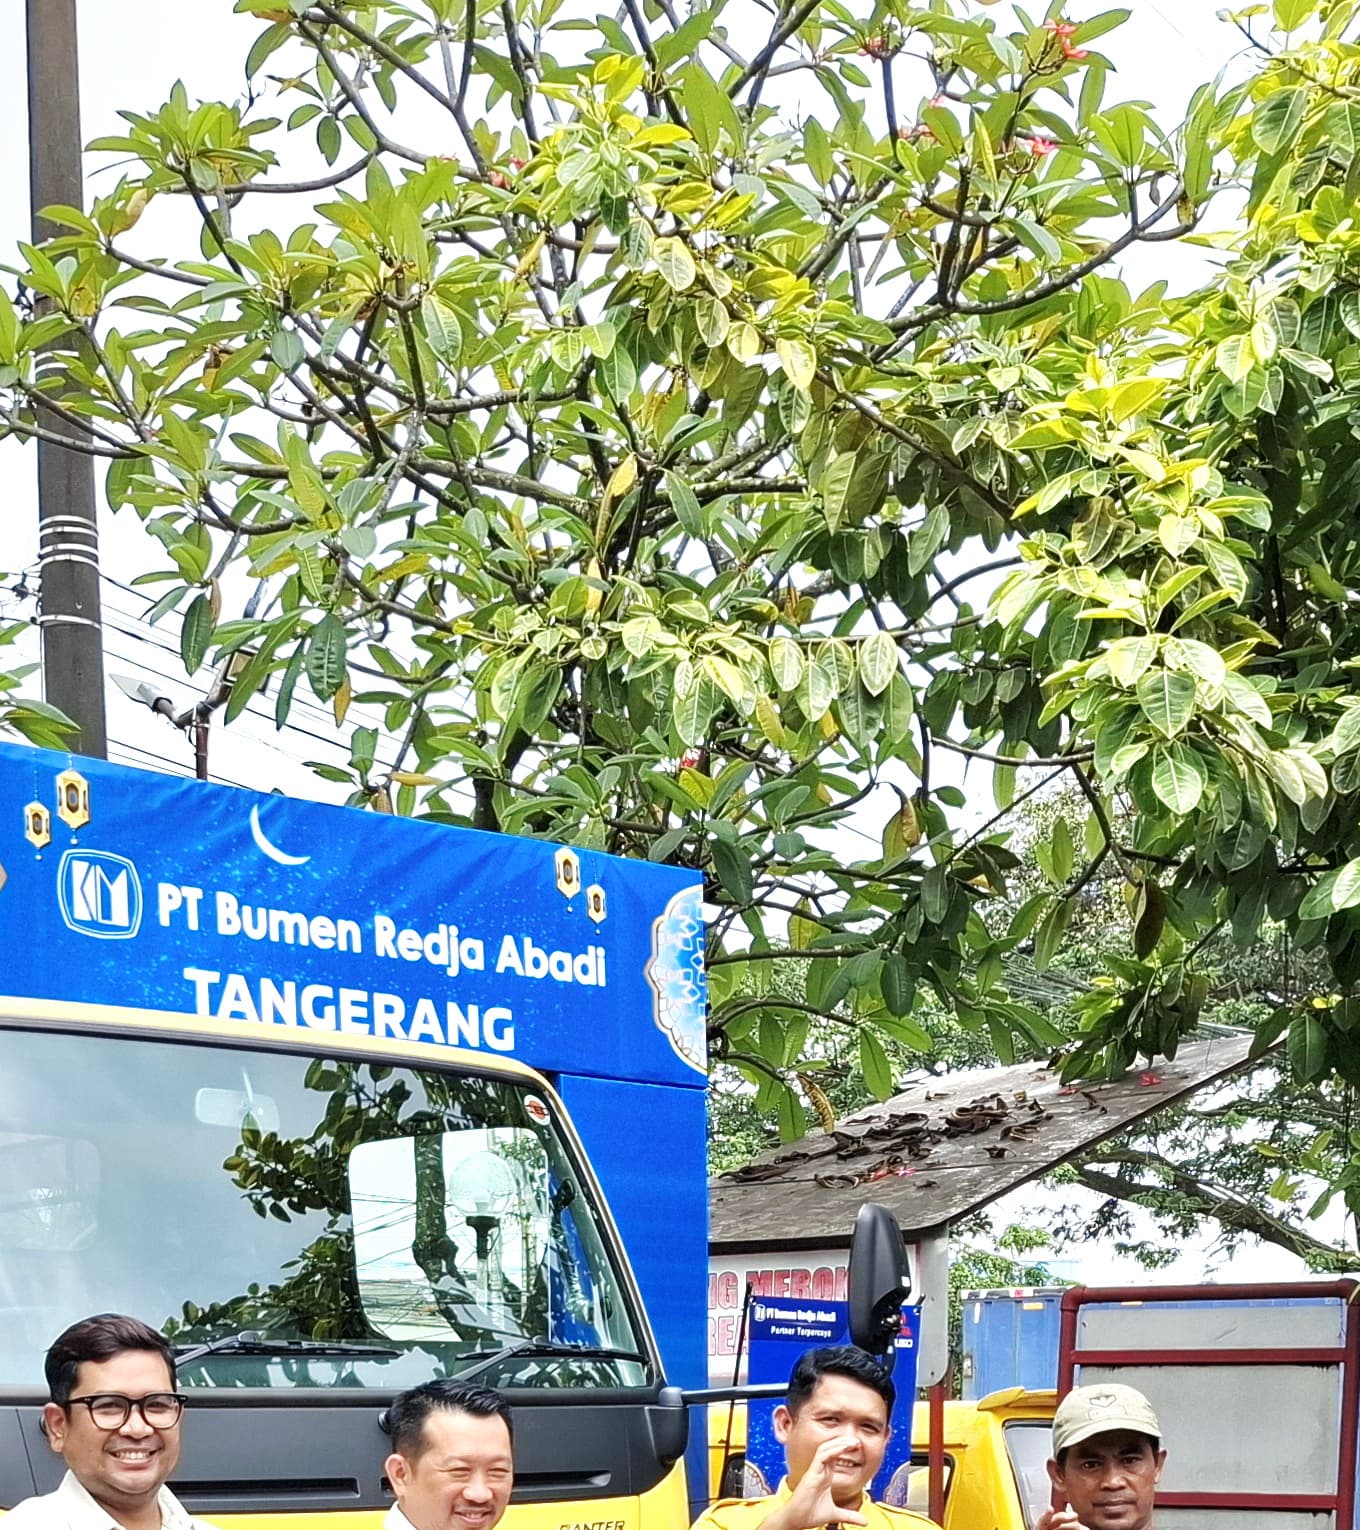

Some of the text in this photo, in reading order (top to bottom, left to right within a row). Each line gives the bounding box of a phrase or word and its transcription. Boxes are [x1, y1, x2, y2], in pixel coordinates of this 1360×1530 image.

[157, 882, 607, 987] PT Bumen Redja Abadi
[183, 967, 515, 1051] TANGERANG
